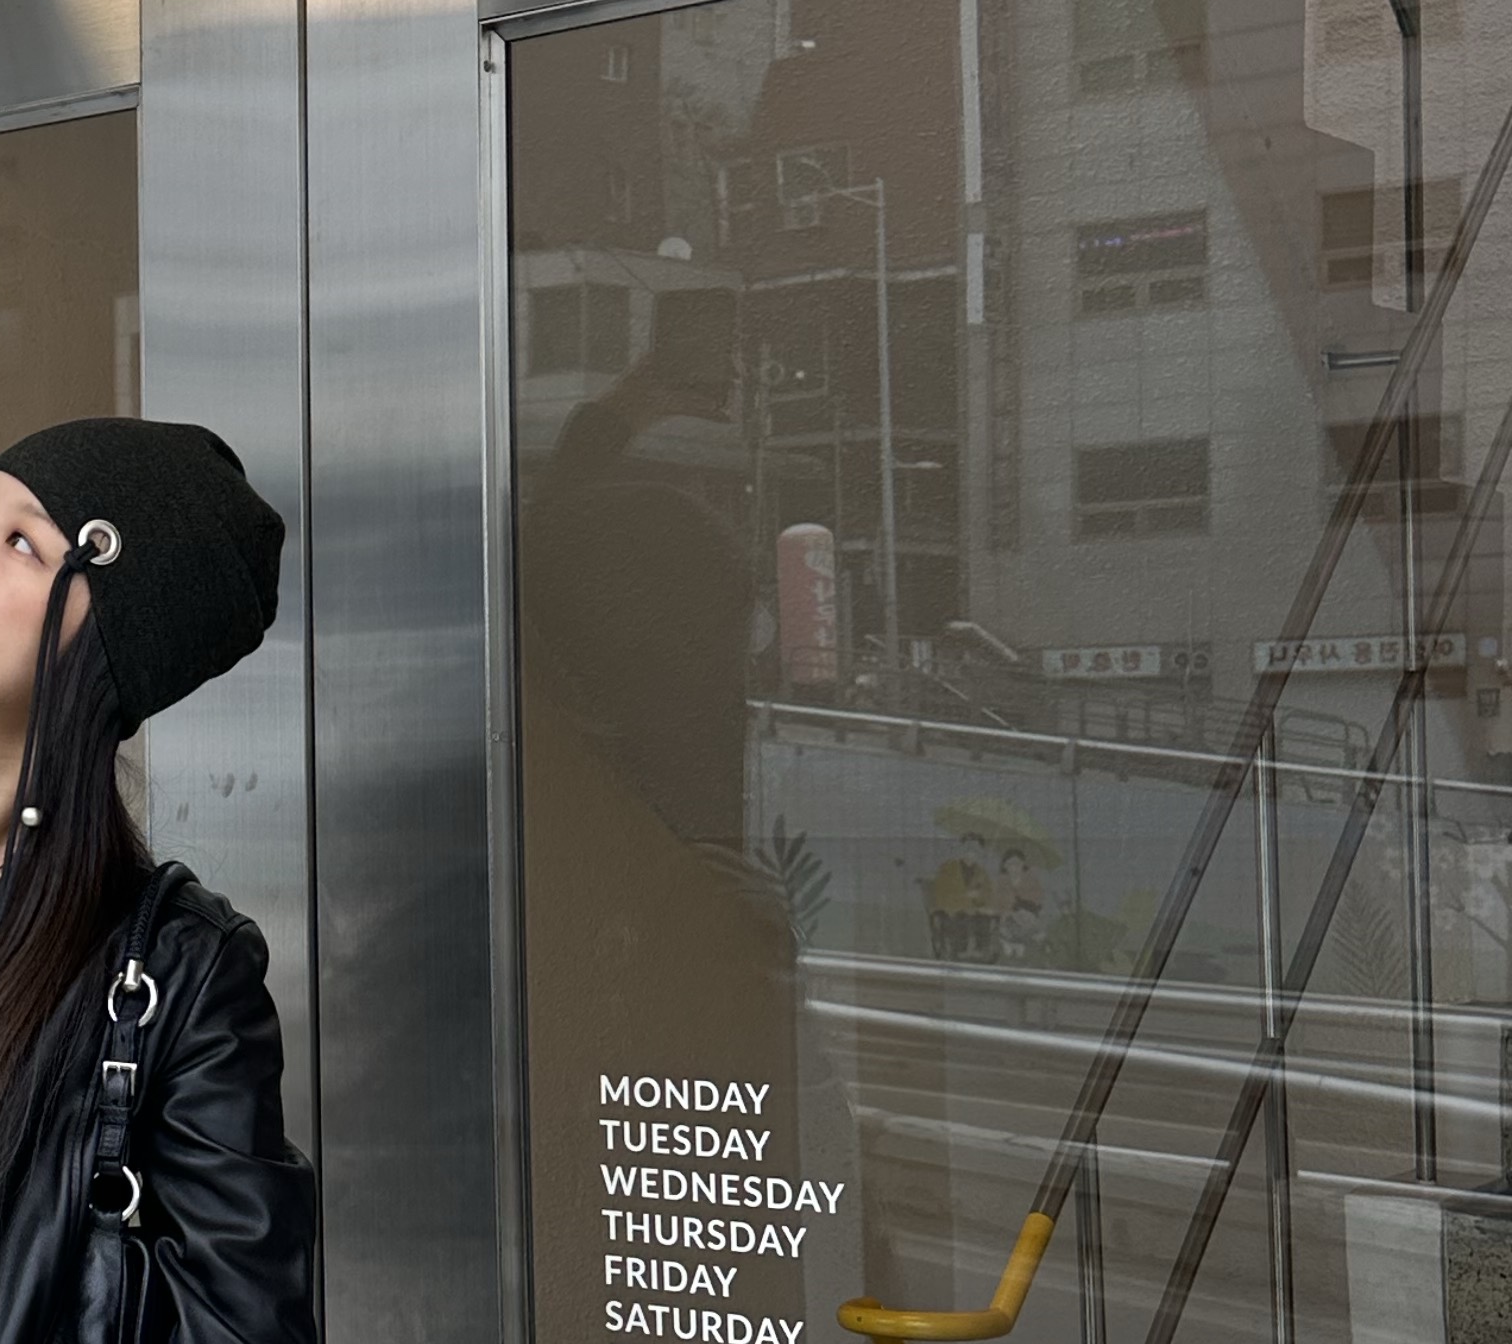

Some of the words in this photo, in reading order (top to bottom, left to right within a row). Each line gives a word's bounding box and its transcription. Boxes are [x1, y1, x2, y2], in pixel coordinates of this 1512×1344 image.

[600, 1074, 770, 1115] MONDAY
[599, 1119, 771, 1161] TUESDAY
[600, 1164, 845, 1214] WEDNESDAY
[601, 1209, 807, 1258] THURSDAY
[605, 1255, 738, 1298] FRIDAY
